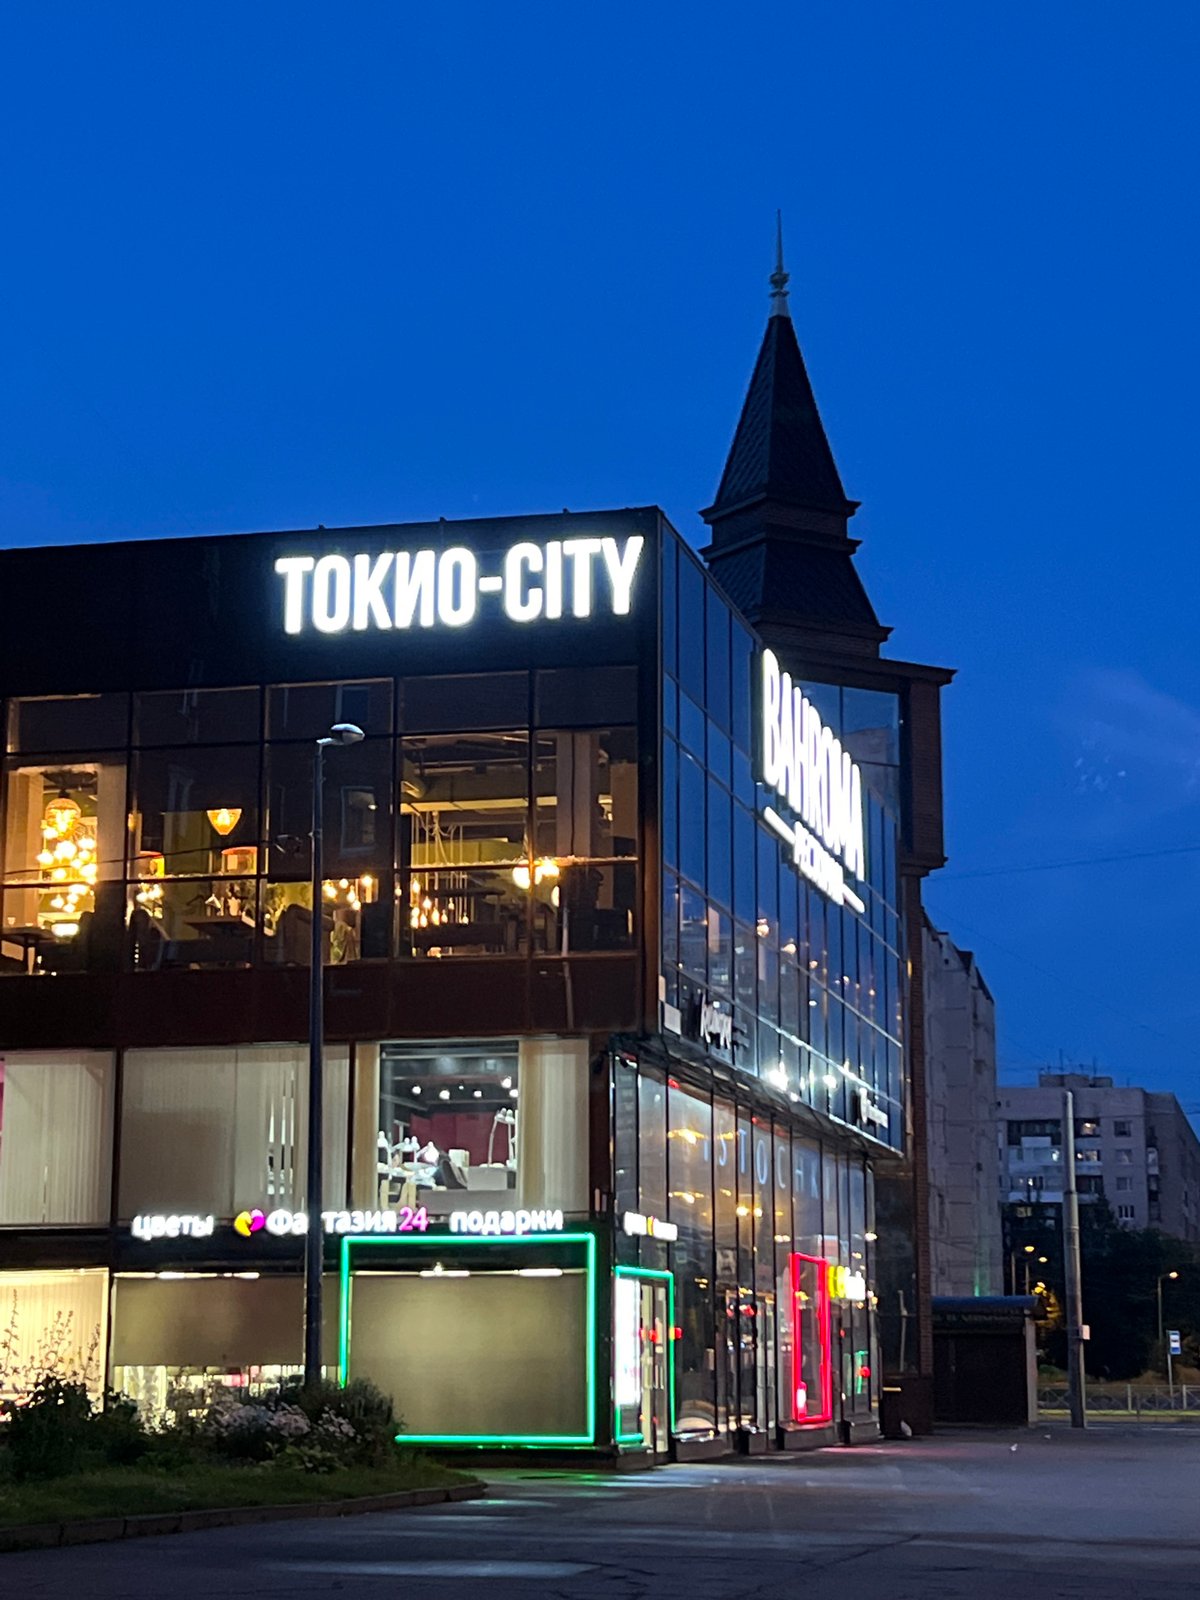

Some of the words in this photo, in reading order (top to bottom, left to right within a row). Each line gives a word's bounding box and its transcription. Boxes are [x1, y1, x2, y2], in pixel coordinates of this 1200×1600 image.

[763, 648, 865, 881] BAHROMA
[132, 1214, 214, 1241] цветы
[265, 1207, 428, 1235] Фатазия24
[450, 1209, 564, 1235] подарки
